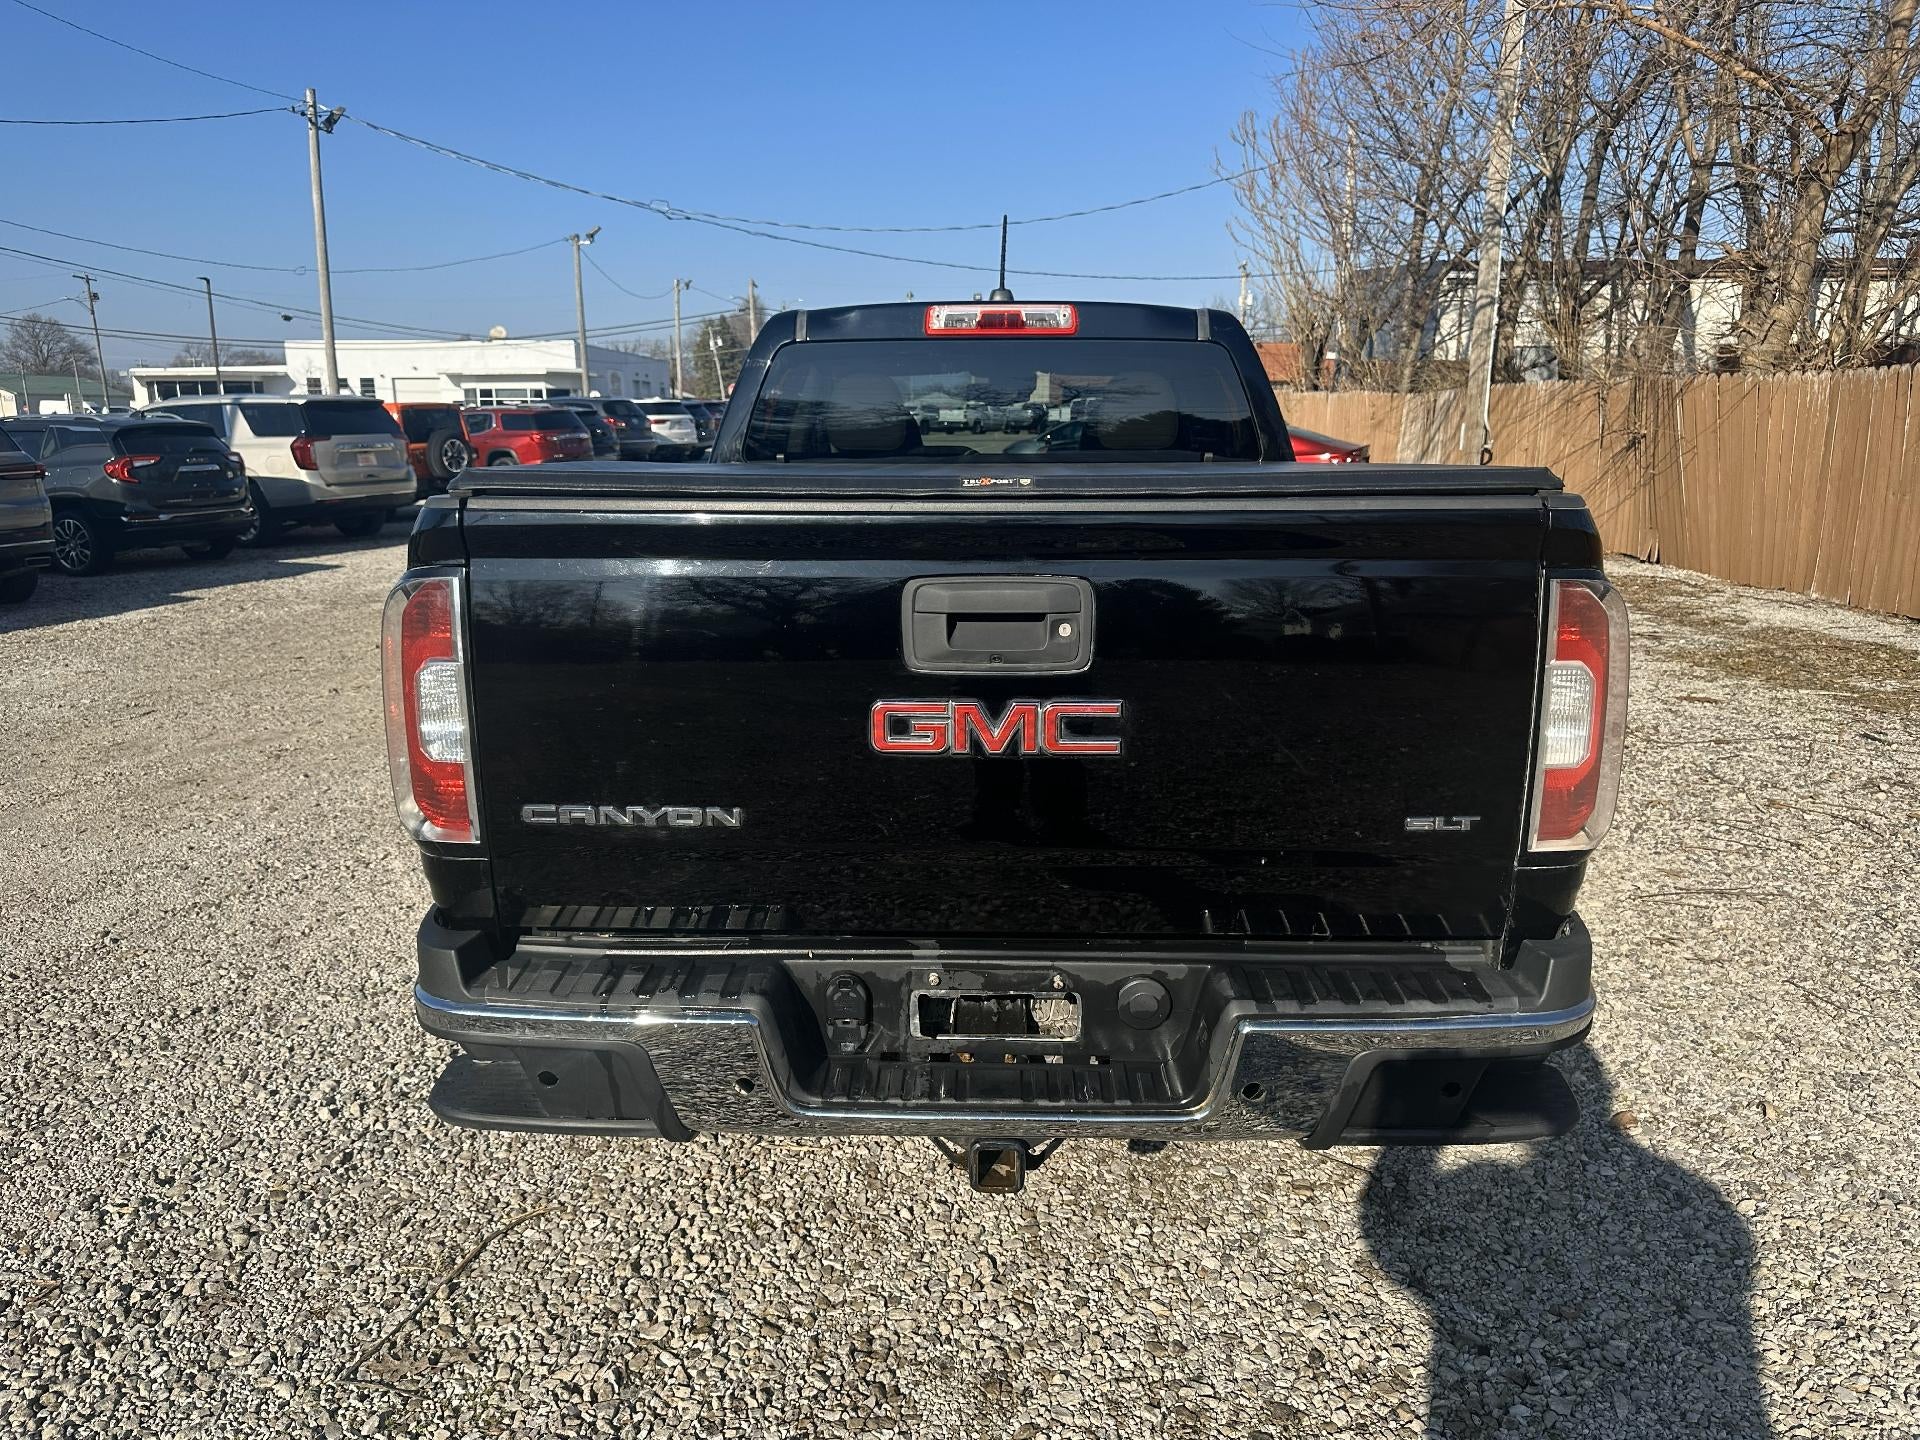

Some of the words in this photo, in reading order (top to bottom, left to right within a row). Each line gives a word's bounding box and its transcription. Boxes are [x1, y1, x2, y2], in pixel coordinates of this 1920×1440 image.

[870, 699, 1124, 756] GMC
[521, 803, 743, 828] CANYON
[1404, 815, 1481, 831] SLT
